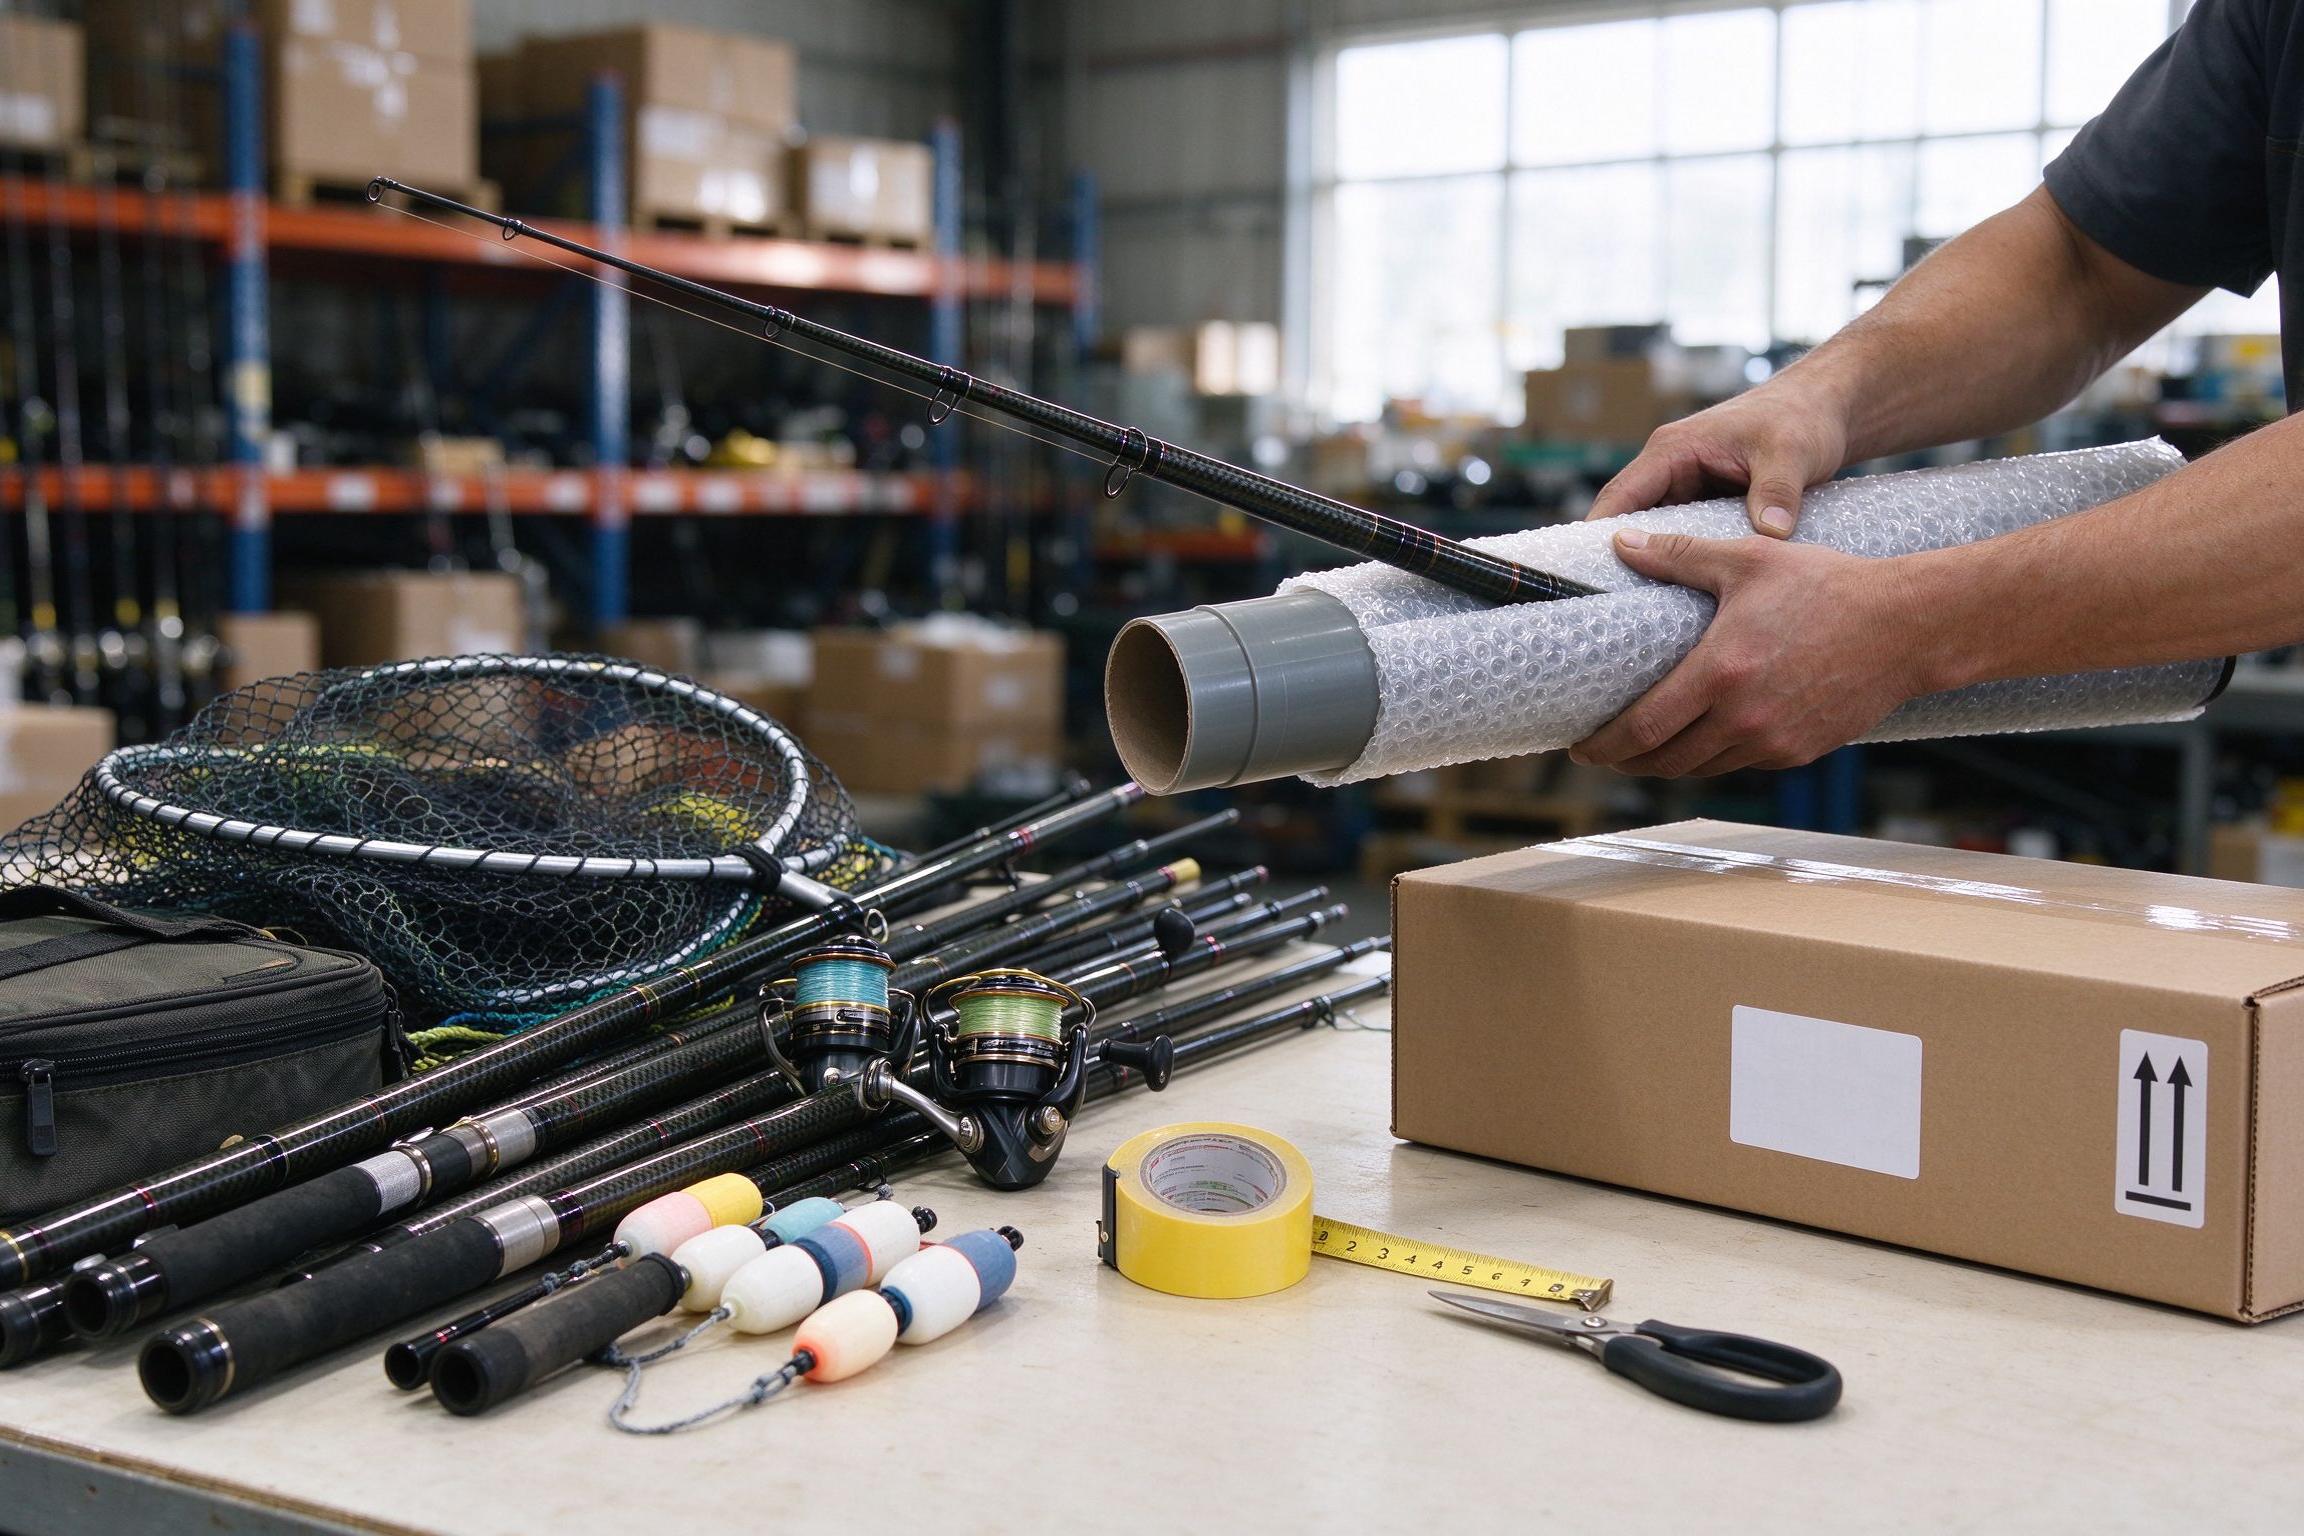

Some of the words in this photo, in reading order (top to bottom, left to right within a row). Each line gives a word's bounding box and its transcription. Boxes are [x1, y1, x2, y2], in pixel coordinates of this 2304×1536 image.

[1346, 1241, 1357, 1252] 2
[1377, 1247, 1389, 1260] 3
[1404, 1255, 1417, 1264] 4
[1461, 1265, 1474, 1275] 5
[1491, 1272, 1503, 1280] 6
